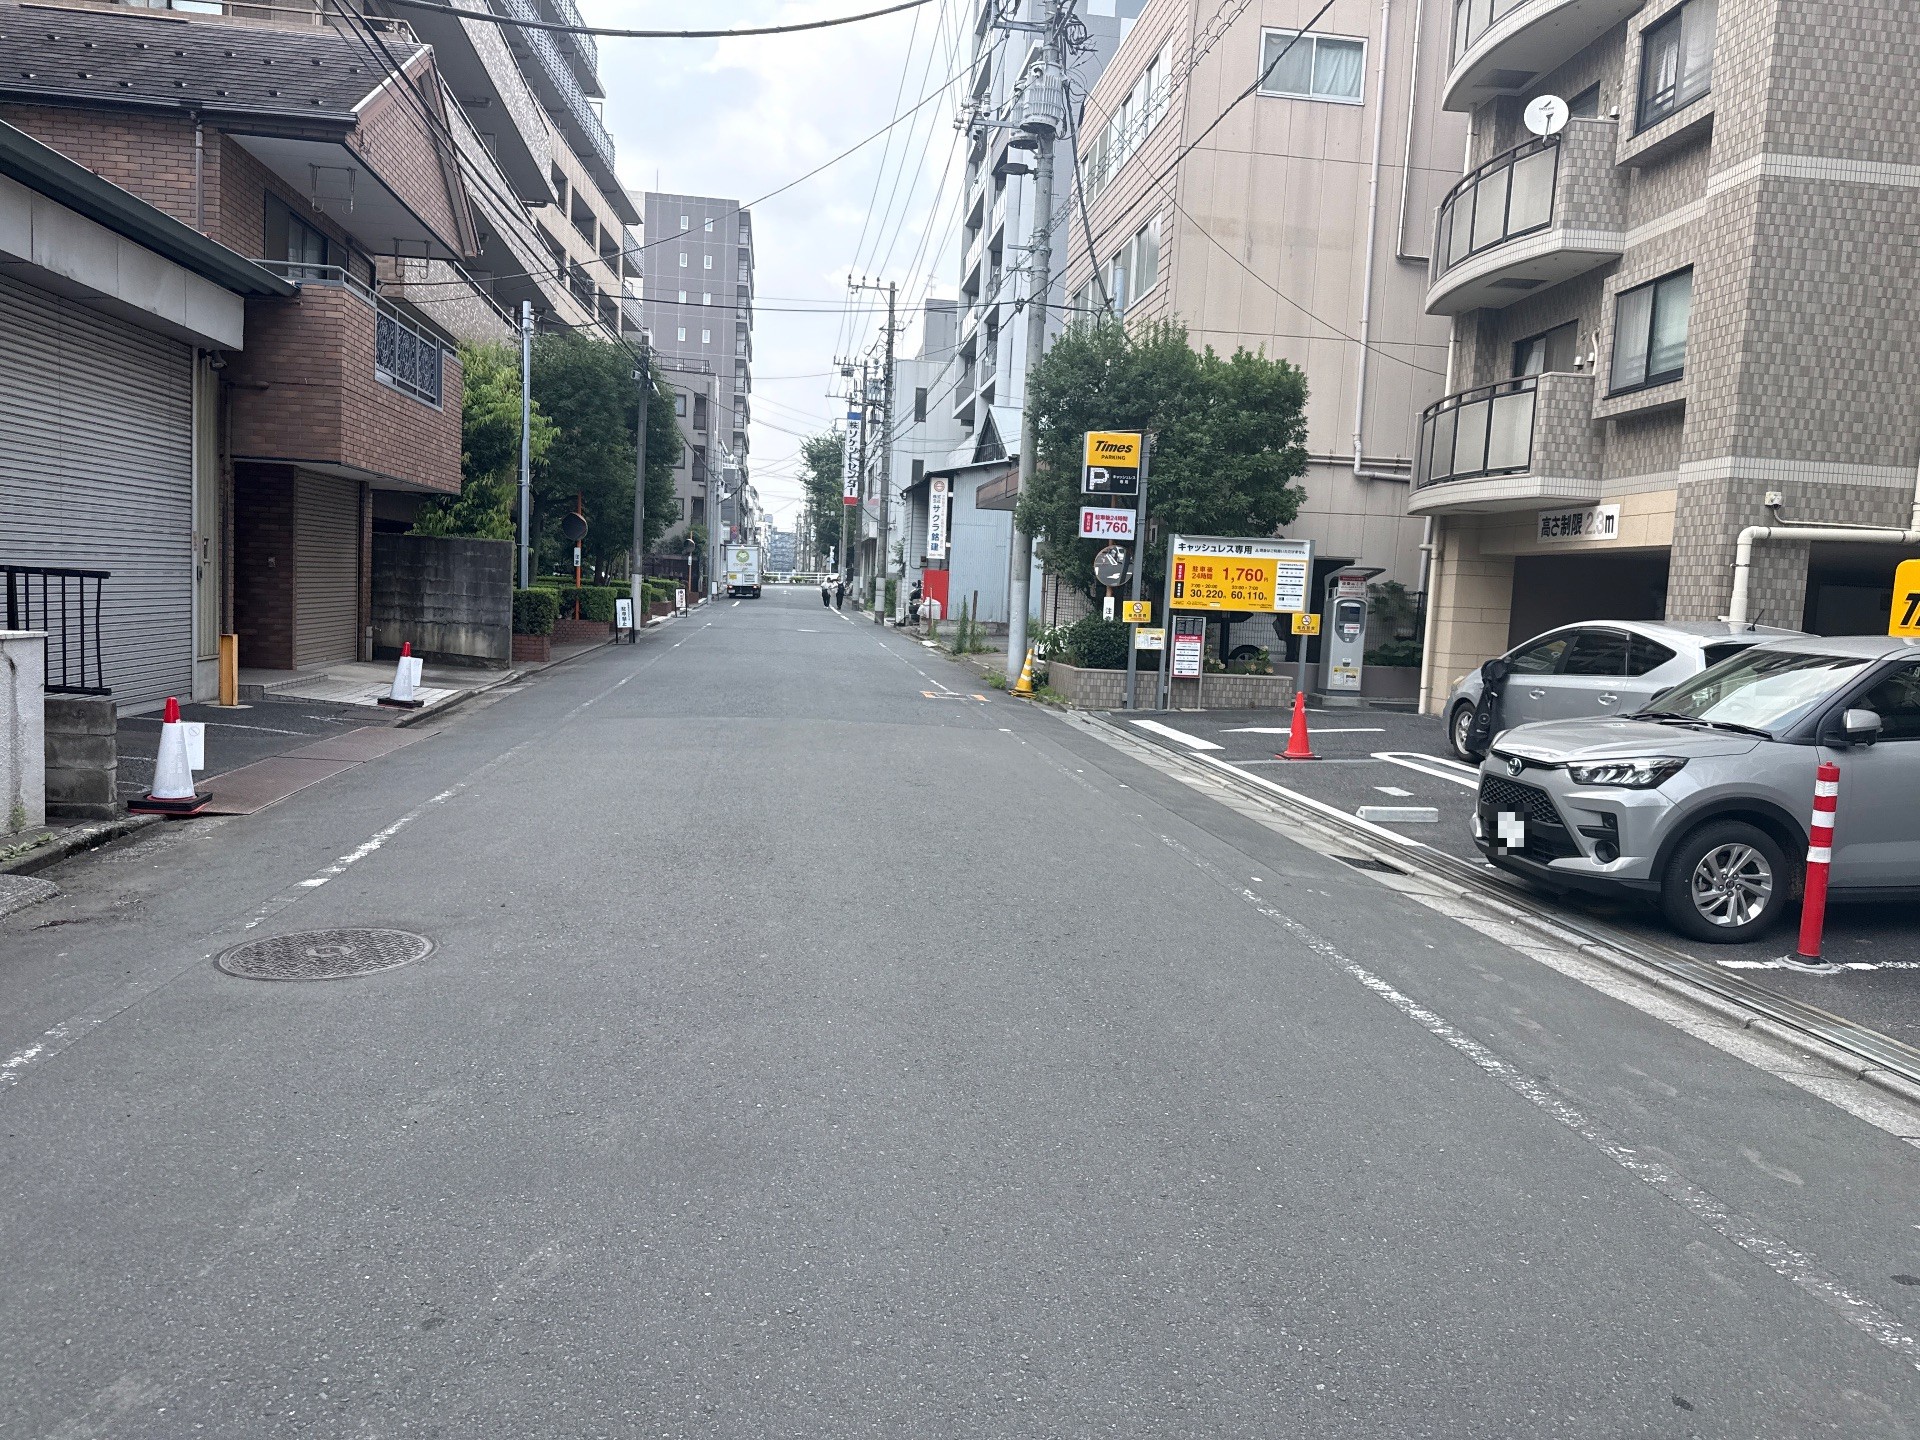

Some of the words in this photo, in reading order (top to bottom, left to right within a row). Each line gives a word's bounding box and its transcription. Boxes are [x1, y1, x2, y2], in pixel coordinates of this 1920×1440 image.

[1095, 440, 1133, 453] Times
[1089, 468, 1110, 490] P
[1095, 520, 1132, 534] 1,760円
[1541, 513, 1583, 537] 高さ制限
[1584, 510, 1614, 535] 2.3m
[1178, 543, 1253, 554] キャッシュレス専用
[1192, 565, 1213, 573] 駐車後
[1222, 567, 1269, 583] 1,760円
[1900, 593, 1920, 627] T
